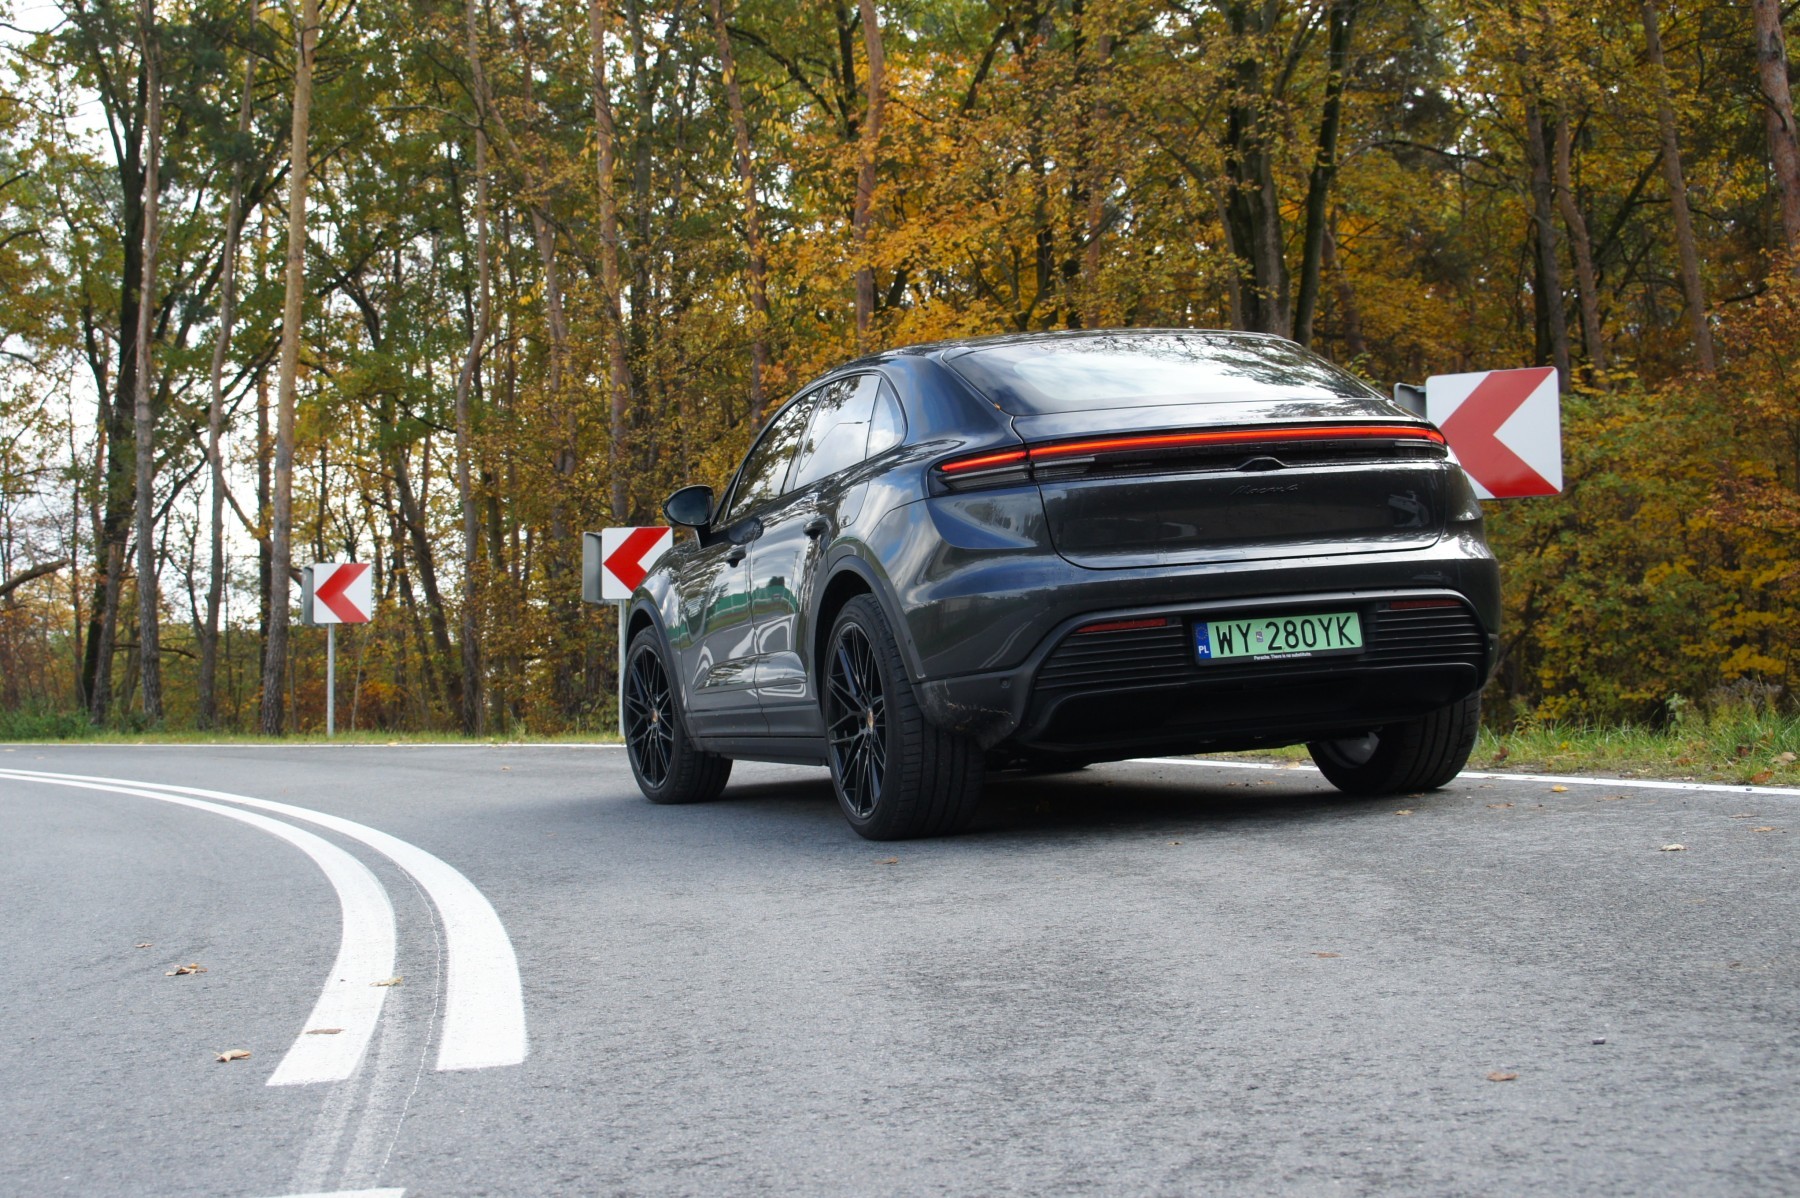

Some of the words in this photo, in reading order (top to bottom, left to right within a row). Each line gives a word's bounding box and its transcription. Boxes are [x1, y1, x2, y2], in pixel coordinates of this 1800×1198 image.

[1215, 623, 1252, 655] WY
[1265, 616, 1355, 651] 280YK
[1198, 645, 1210, 655] PL
